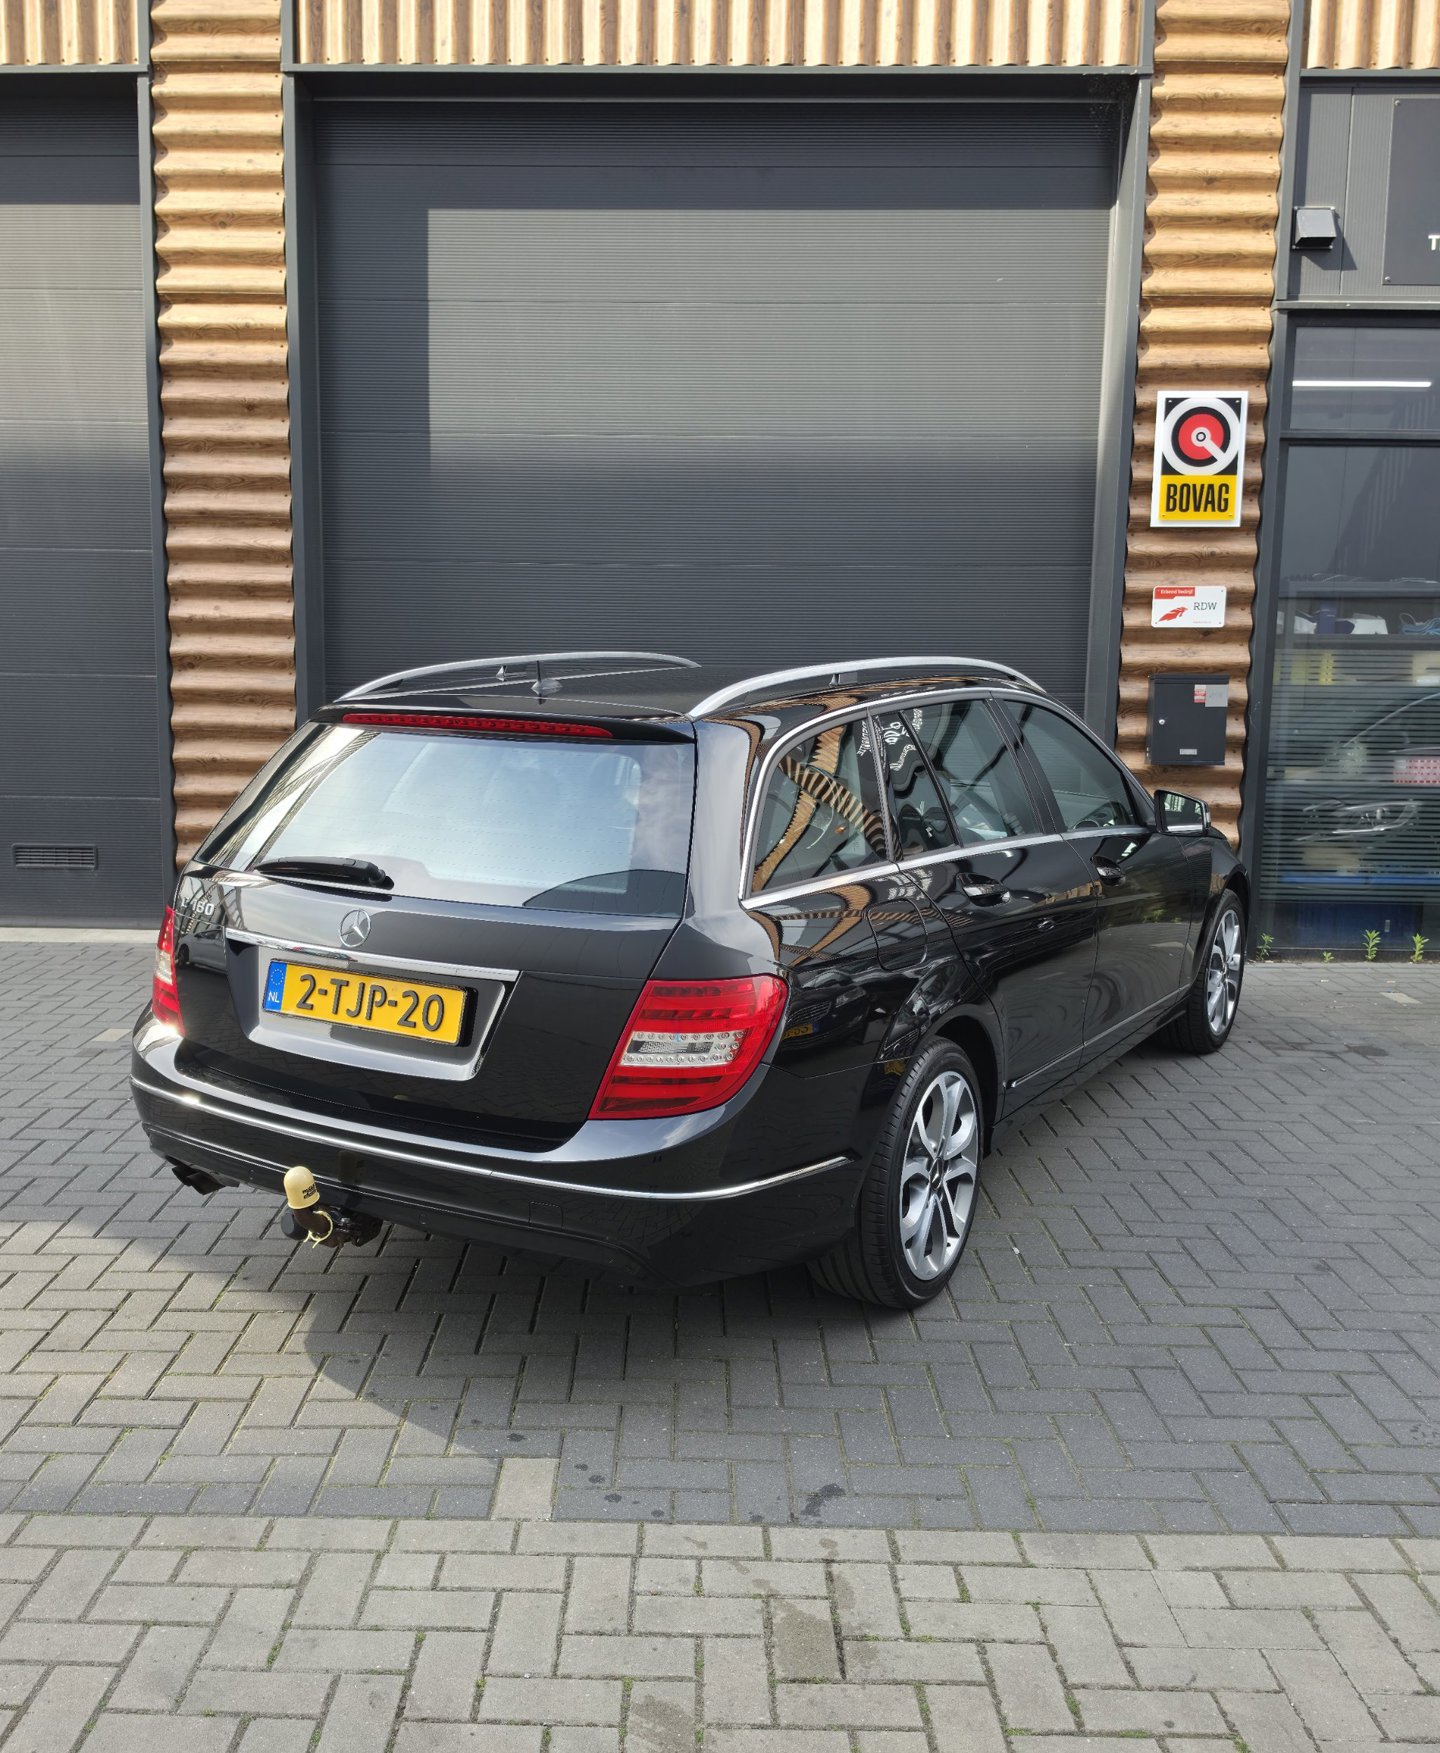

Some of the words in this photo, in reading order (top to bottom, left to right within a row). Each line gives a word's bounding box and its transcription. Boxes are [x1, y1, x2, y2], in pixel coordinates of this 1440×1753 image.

[1428, 234, 1440, 250] T
[1165, 483, 1230, 513] BOVAG
[1193, 602, 1217, 611] RDW
[268, 991, 280, 1003] NL
[296, 974, 445, 1032] 2-TJP-20
